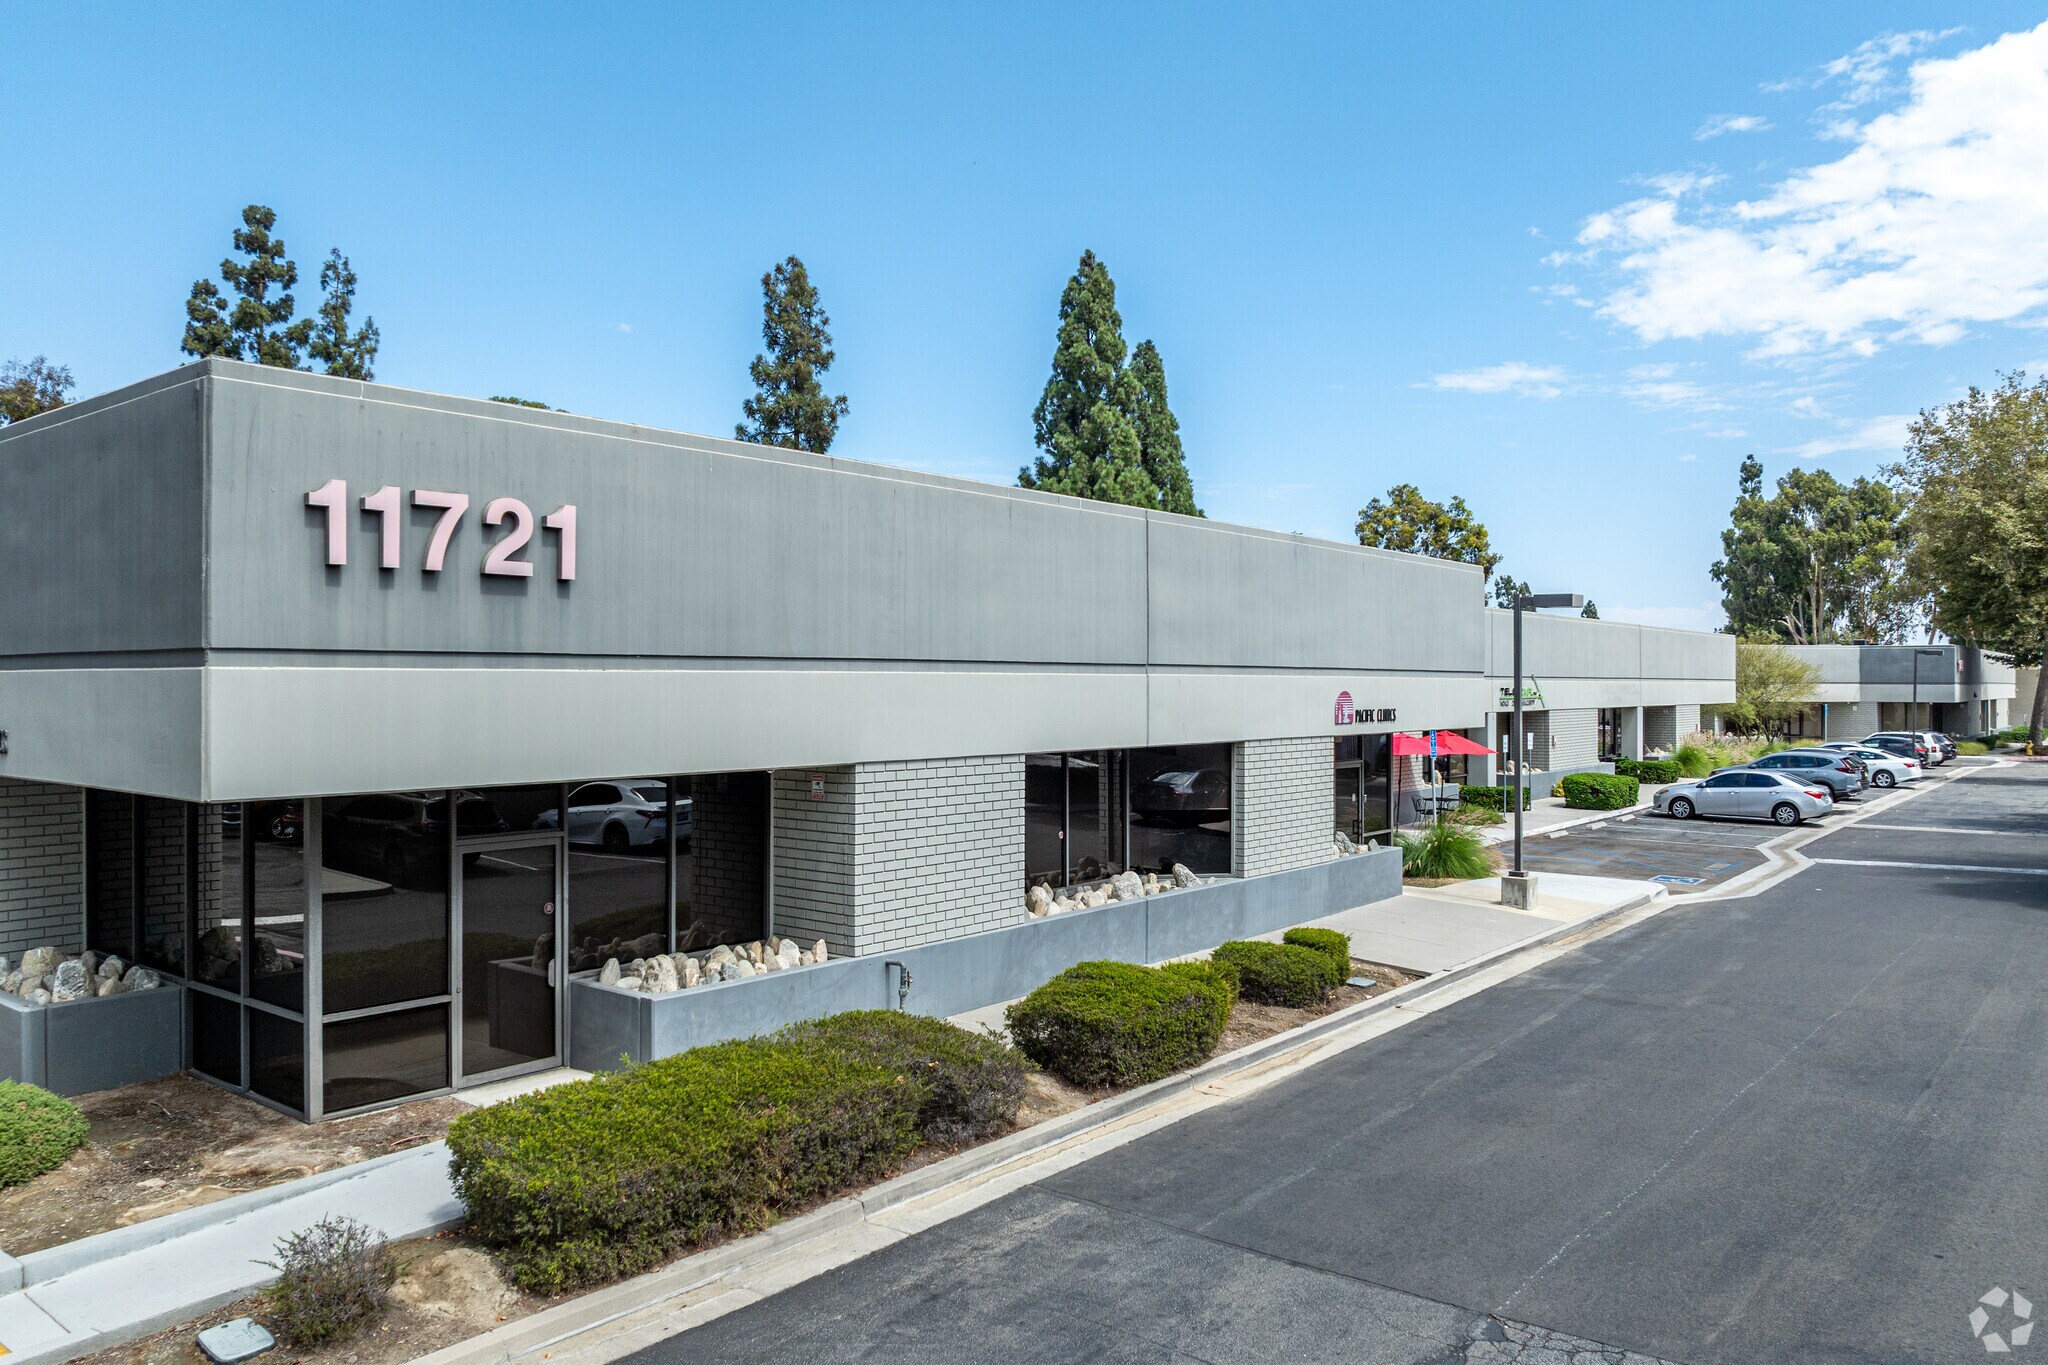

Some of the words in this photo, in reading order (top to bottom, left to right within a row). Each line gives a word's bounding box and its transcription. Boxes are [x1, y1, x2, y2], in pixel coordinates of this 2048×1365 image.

[304, 479, 577, 580] 11721
[1354, 708, 1375, 723] PACIFIC
[1376, 707, 1397, 722] CLINICS
